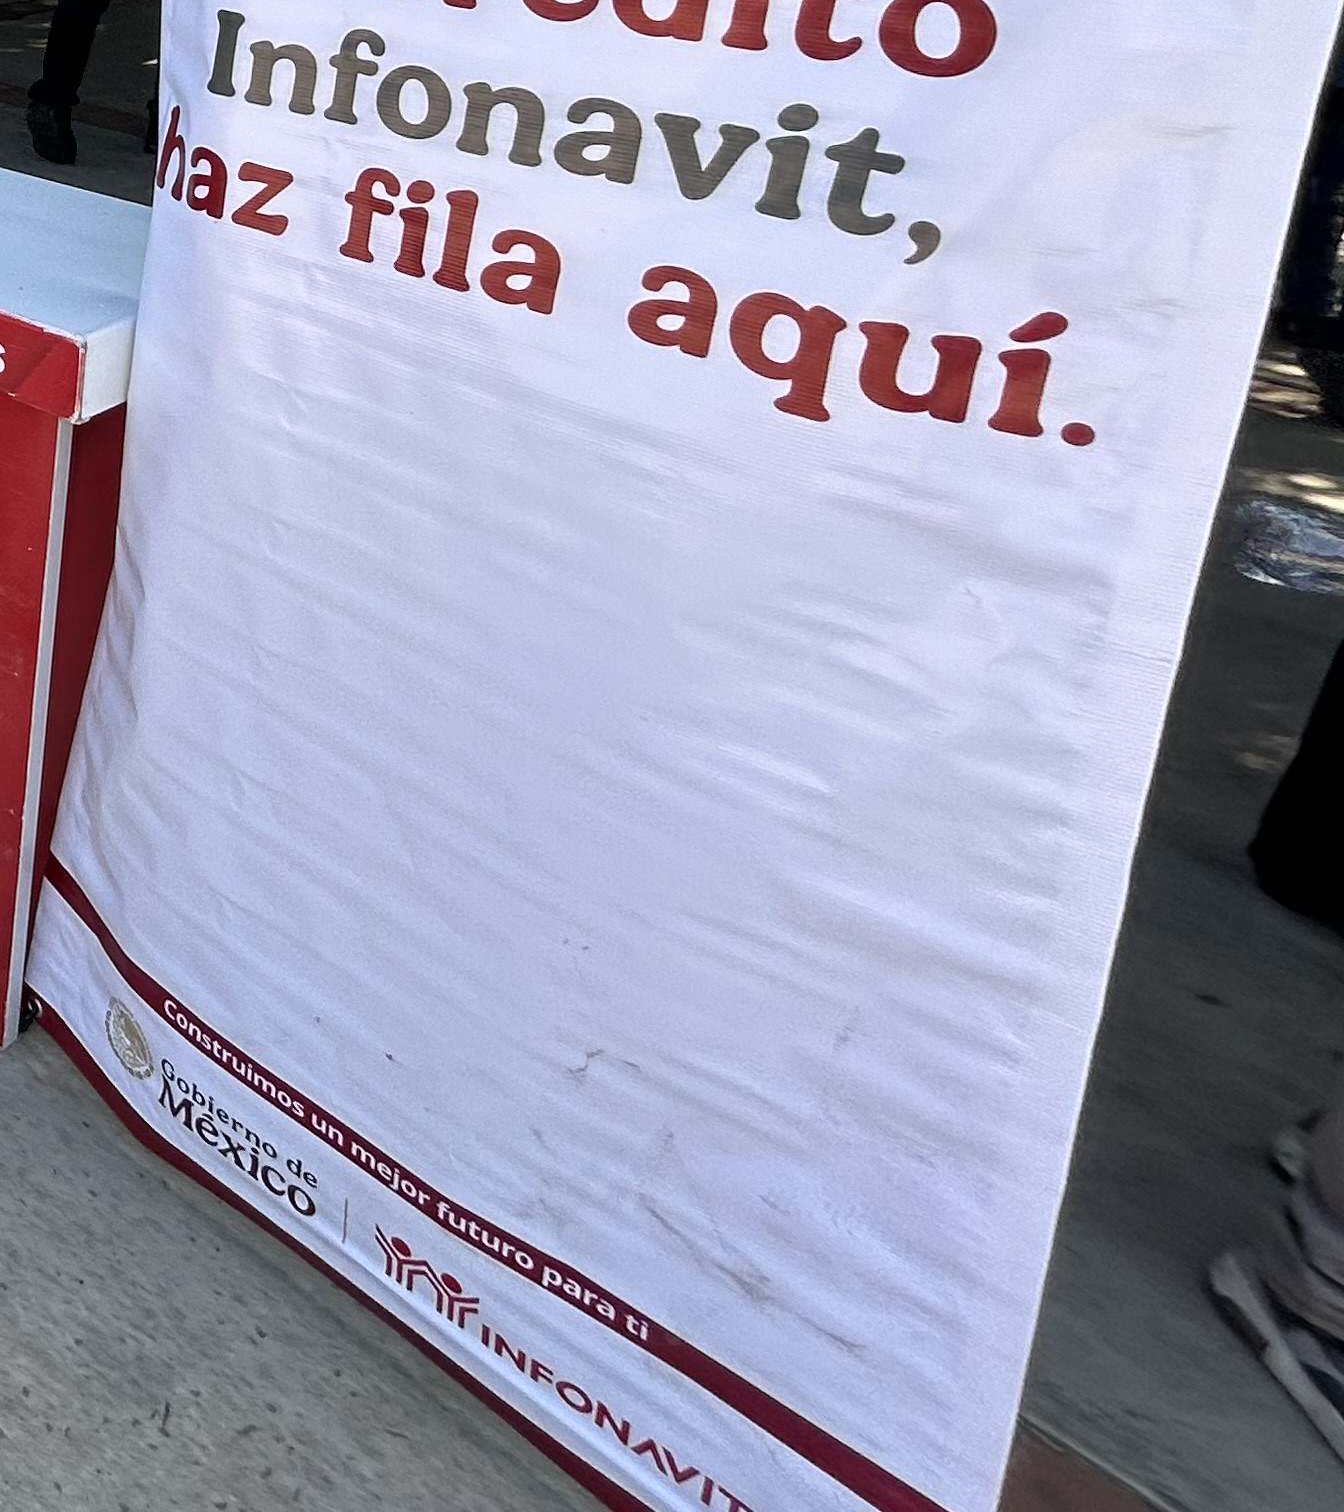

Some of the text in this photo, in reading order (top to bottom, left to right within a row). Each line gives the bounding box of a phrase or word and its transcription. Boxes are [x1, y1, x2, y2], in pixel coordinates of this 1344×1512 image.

[206, 9, 943, 265] Infonavit,
[155, 106, 1095, 447] haz fila aquí.
[159, 1075, 316, 1216] México
[161, 1058, 318, 1189] Gobierno de
[163, 999, 650, 1343] Construimos un mejor futuro para ti
[481, 1324, 754, 1512] INFONAVIT
